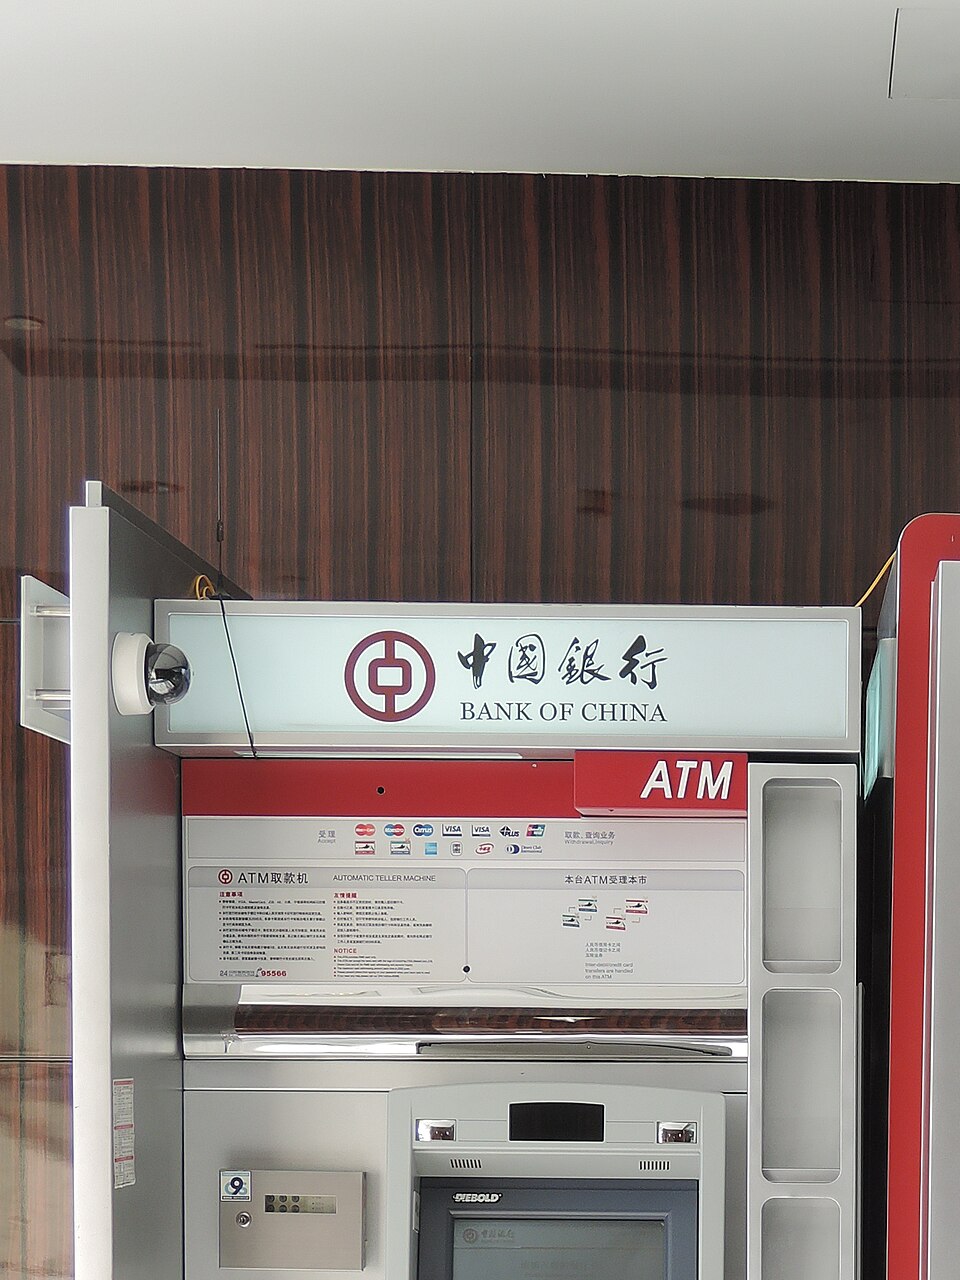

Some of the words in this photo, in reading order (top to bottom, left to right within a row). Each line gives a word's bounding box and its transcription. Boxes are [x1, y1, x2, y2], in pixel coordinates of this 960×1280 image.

[460, 703, 532, 720] BANK
[540, 703, 573, 721] OF
[581, 703, 667, 722] CHINA
[640, 761, 733, 799] ATM
[318, 830, 336, 838] 受理
[238, 872, 309, 885] ATM取款机
[333, 874, 374, 882] AUTOMATIC
[564, 875, 647, 885] 本台ATM受理本市
[454, 1193, 500, 1202] DIEBOLD
